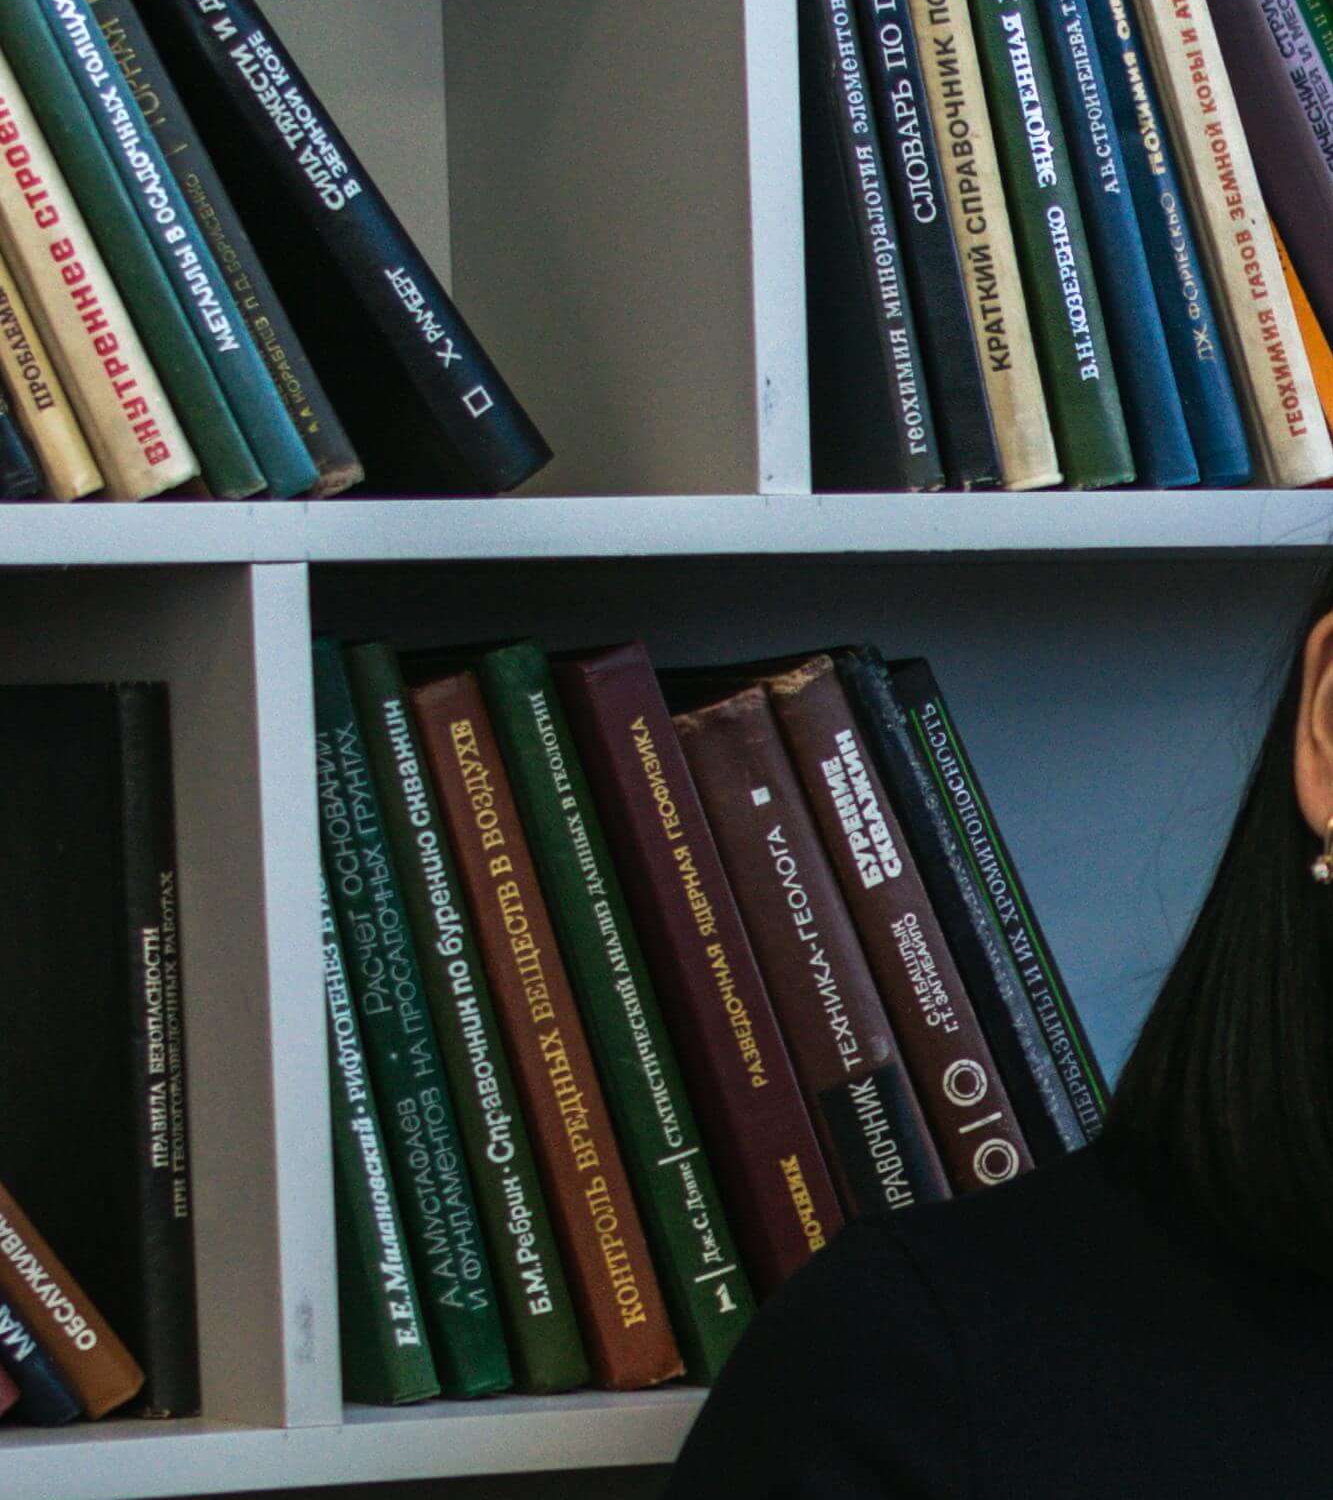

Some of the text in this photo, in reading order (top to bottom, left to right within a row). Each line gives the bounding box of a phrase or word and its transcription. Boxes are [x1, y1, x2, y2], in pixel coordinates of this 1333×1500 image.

[212, 15, 238, 41] И
[877, 21, 909, 71] ПО
[1178, 25, 1198, 45] И
[1184, 47, 1218, 115] КОРЫ
[1295, 42, 1315, 62] И
[97, 83, 180, 226] ОСАДОЧНЫХ
[228, 40, 308, 150] ТЯЖЕСТИ
[246, 28, 362, 199] В ЗЕМНОЙ КОРЕ
[888, 78, 939, 225] СЛОВАРЬ
[932, 32, 992, 236] СПРАВОЧНИК
[1001, 9, 1061, 189] ЭНДОГЕННАЯ
[294, 143, 348, 214] СИЛА
[851, 141, 908, 320] минералогия
[1201, 119, 1248, 223] ЗЕМНОЙ
[163, 222, 186, 244] В
[1233, 226, 1270, 301] ГАЗОВ
[172, 242, 240, 355] МЕТАЛЛЫ
[383, 259, 445, 344] РАМБЕРГ
[965, 243, 1013, 373] КРАТКИЙ
[886, 326, 930, 456] геохимия
[1257, 306, 1308, 438] ГЕОХИМИЯ
[333, 721, 379, 835] ГРУНТАХ
[820, 753, 886, 890] БУРЕНИЕ
[833, 725, 906, 881] СКВАЖИН
[628, 714, 771, 1089] РАЗВЕДОЧНАЯ ЯДЕРНАЯ ГЕОФИЗИКА
[916, 699, 1043, 985] И ИХ ХРОМИТОНОСНОСТЬ
[160, 870, 177, 954] РАБОТАХ
[382, 696, 521, 1165] Справочник по бурению скважин
[527, 690, 684, 1150] СТАТИСТИЧЕСКИЙ АНАЛИЗ ДАННЫХ В ГЕОЛОГИИ
[901, 909, 950, 1007] ЗАГИБАЙЛО
[142, 926, 169, 1167] ПРАВИЛА БЕЗОПАСНОСТИ
[406, 1036, 435, 1077] НА
[448, 716, 648, 1327] КОНТРОЛЬ ВРЕДНЫХ ВЕЩЕСТВ В ВОЗДУХЕ
[762, 822, 915, 1211] РАВОЧНИК ТЕХНИКА-ГЕОЛОГА
[174, 1177, 189, 1217] ПРИ
[777, 1153, 827, 1252] ВОЧНИК
